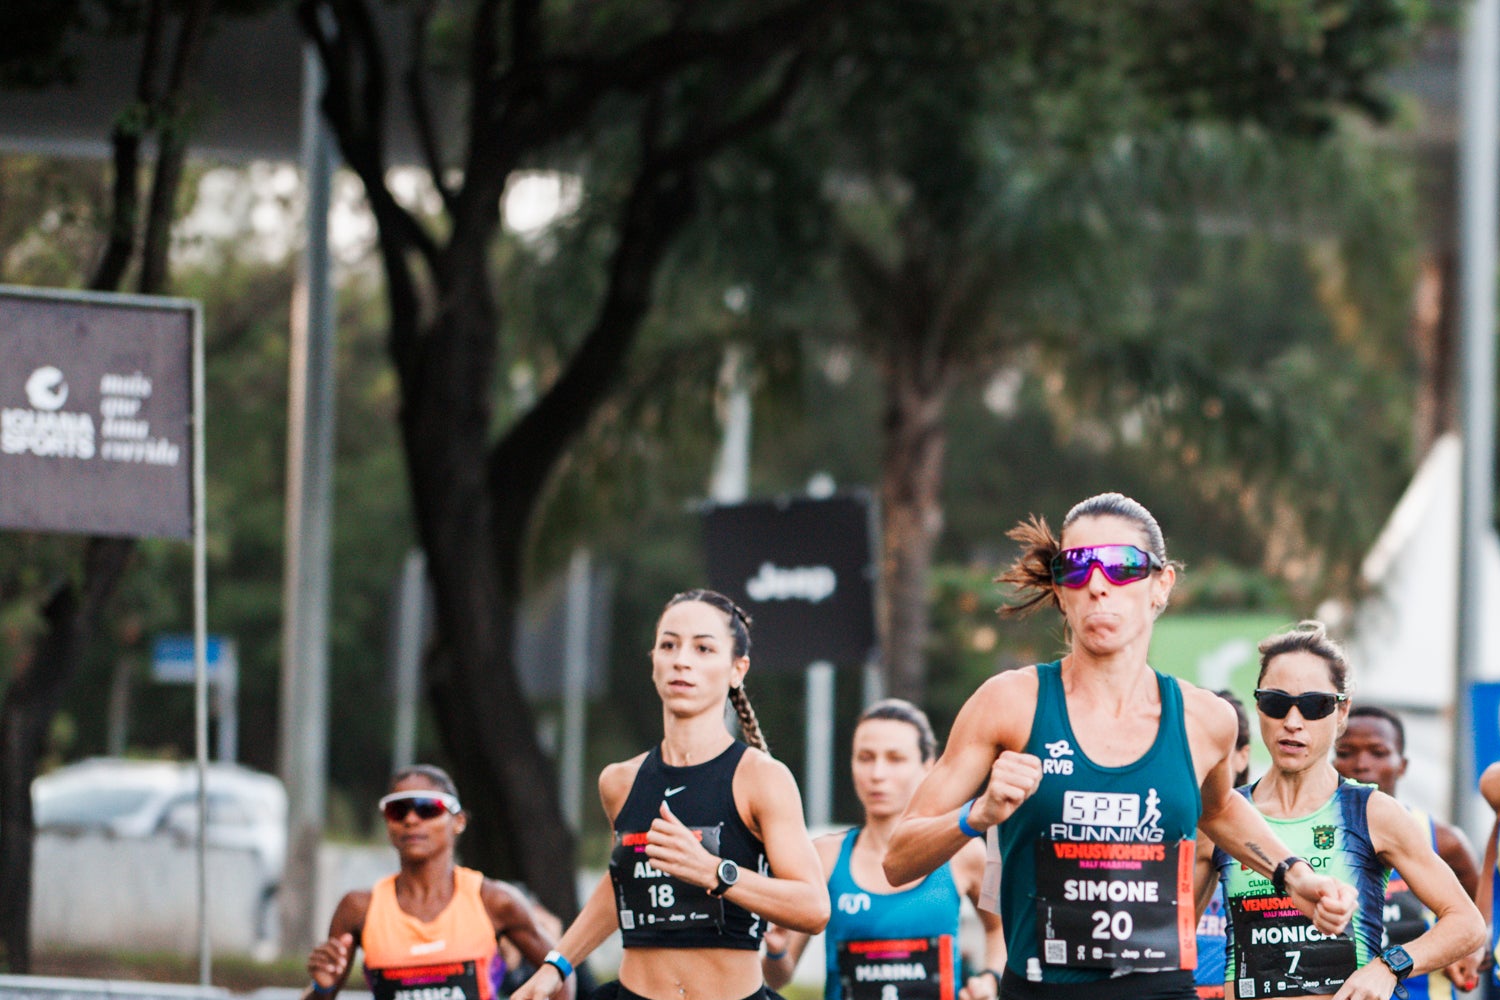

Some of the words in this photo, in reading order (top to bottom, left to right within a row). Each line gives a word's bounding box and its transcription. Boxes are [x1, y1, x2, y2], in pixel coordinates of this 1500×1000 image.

[1, 432, 95, 459] SPORTS
[1043, 759, 1074, 775] RVB
[1070, 795, 1132, 822] SPF
[1050, 823, 1165, 842] RUNNING
[648, 884, 675, 908] 18
[1064, 880, 1159, 902] SIMONE
[1092, 910, 1133, 941] 20
[855, 963, 926, 982] MARINA
[1285, 951, 1301, 974] 7
